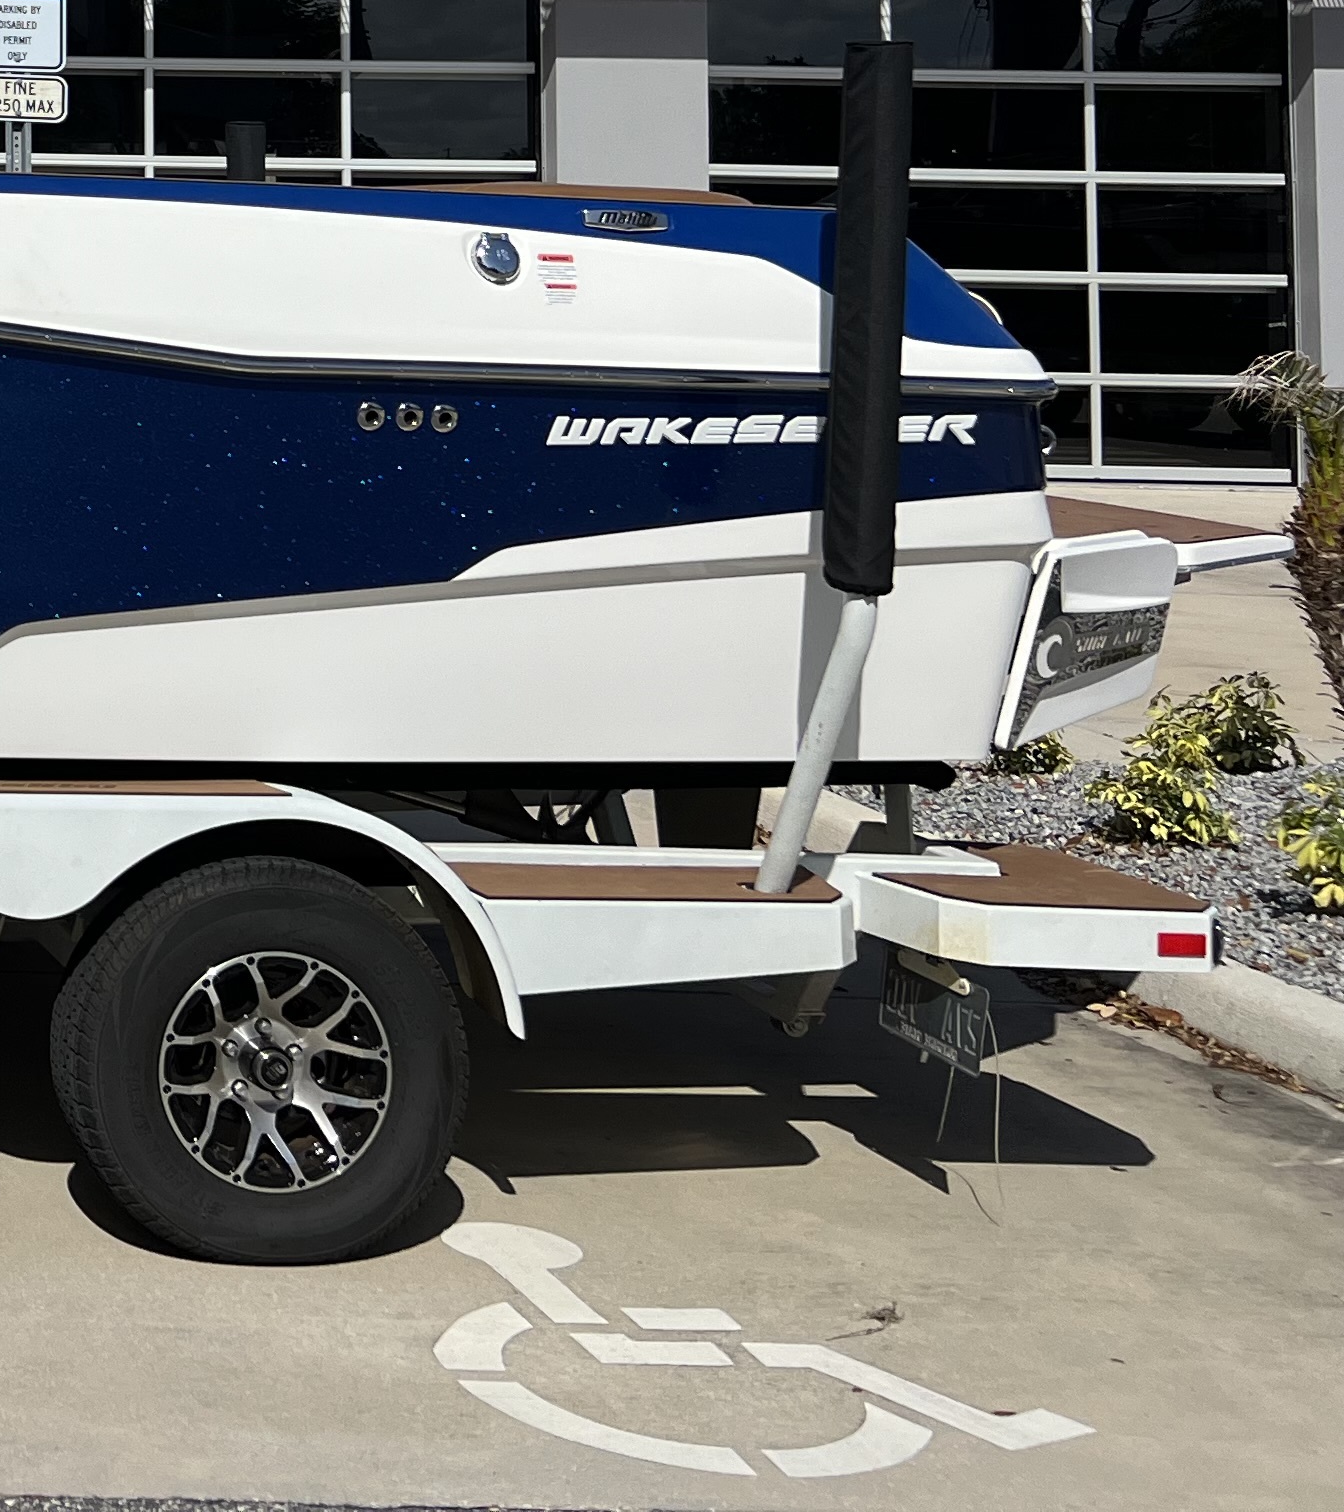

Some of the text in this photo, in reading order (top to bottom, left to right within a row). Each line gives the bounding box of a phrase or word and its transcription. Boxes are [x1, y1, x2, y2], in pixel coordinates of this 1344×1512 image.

[30, 6, 42, 15] BY
[3, 36, 32, 45] PERMIT
[4, 82, 37, 96] FINE
[25, 99, 55, 114] MAX
[546, 414, 978, 446] WAKESEER
